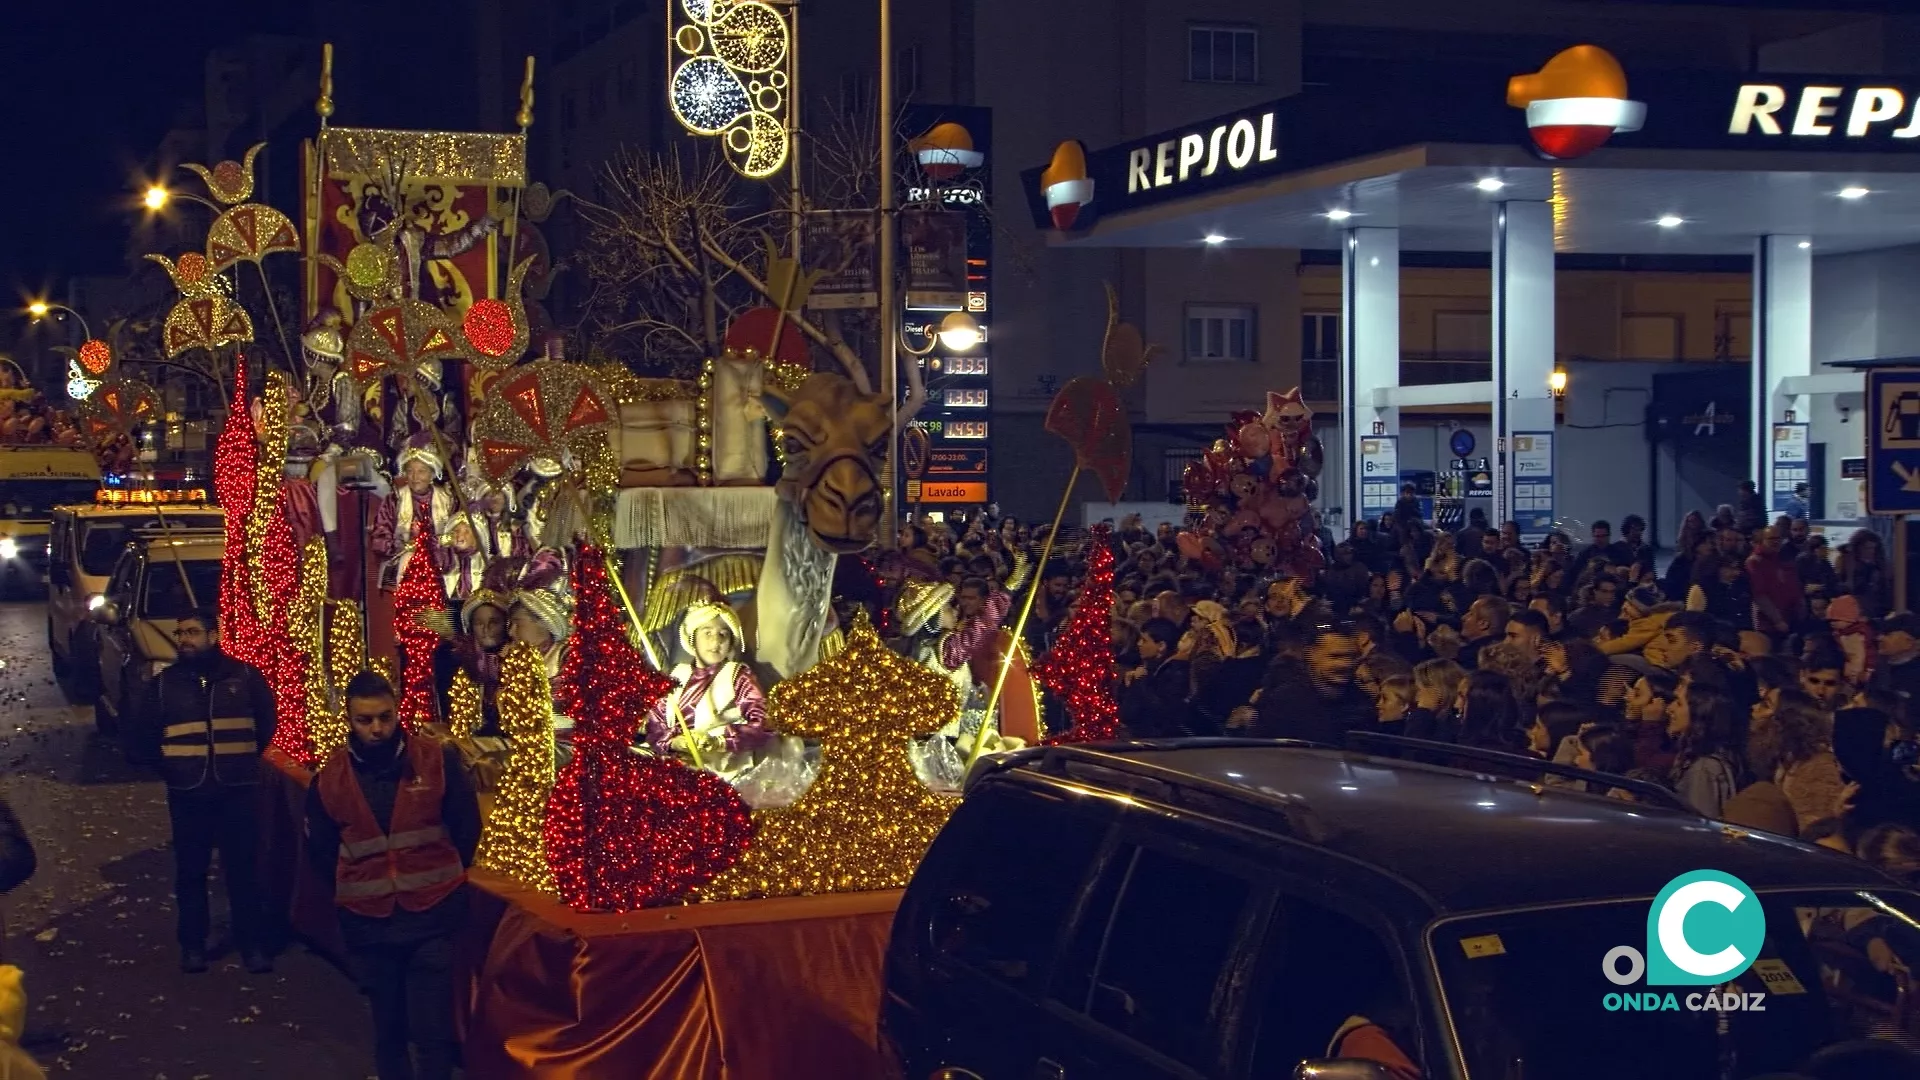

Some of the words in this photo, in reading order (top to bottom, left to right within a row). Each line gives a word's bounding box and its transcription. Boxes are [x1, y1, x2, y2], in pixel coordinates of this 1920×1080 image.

[1128, 112, 1278, 194] REPSOL
[905, 325, 923, 333] Diesel
[1512, 389, 1518, 399] 4
[929, 420, 942, 432] 98
[928, 486, 966, 497] Lavado
